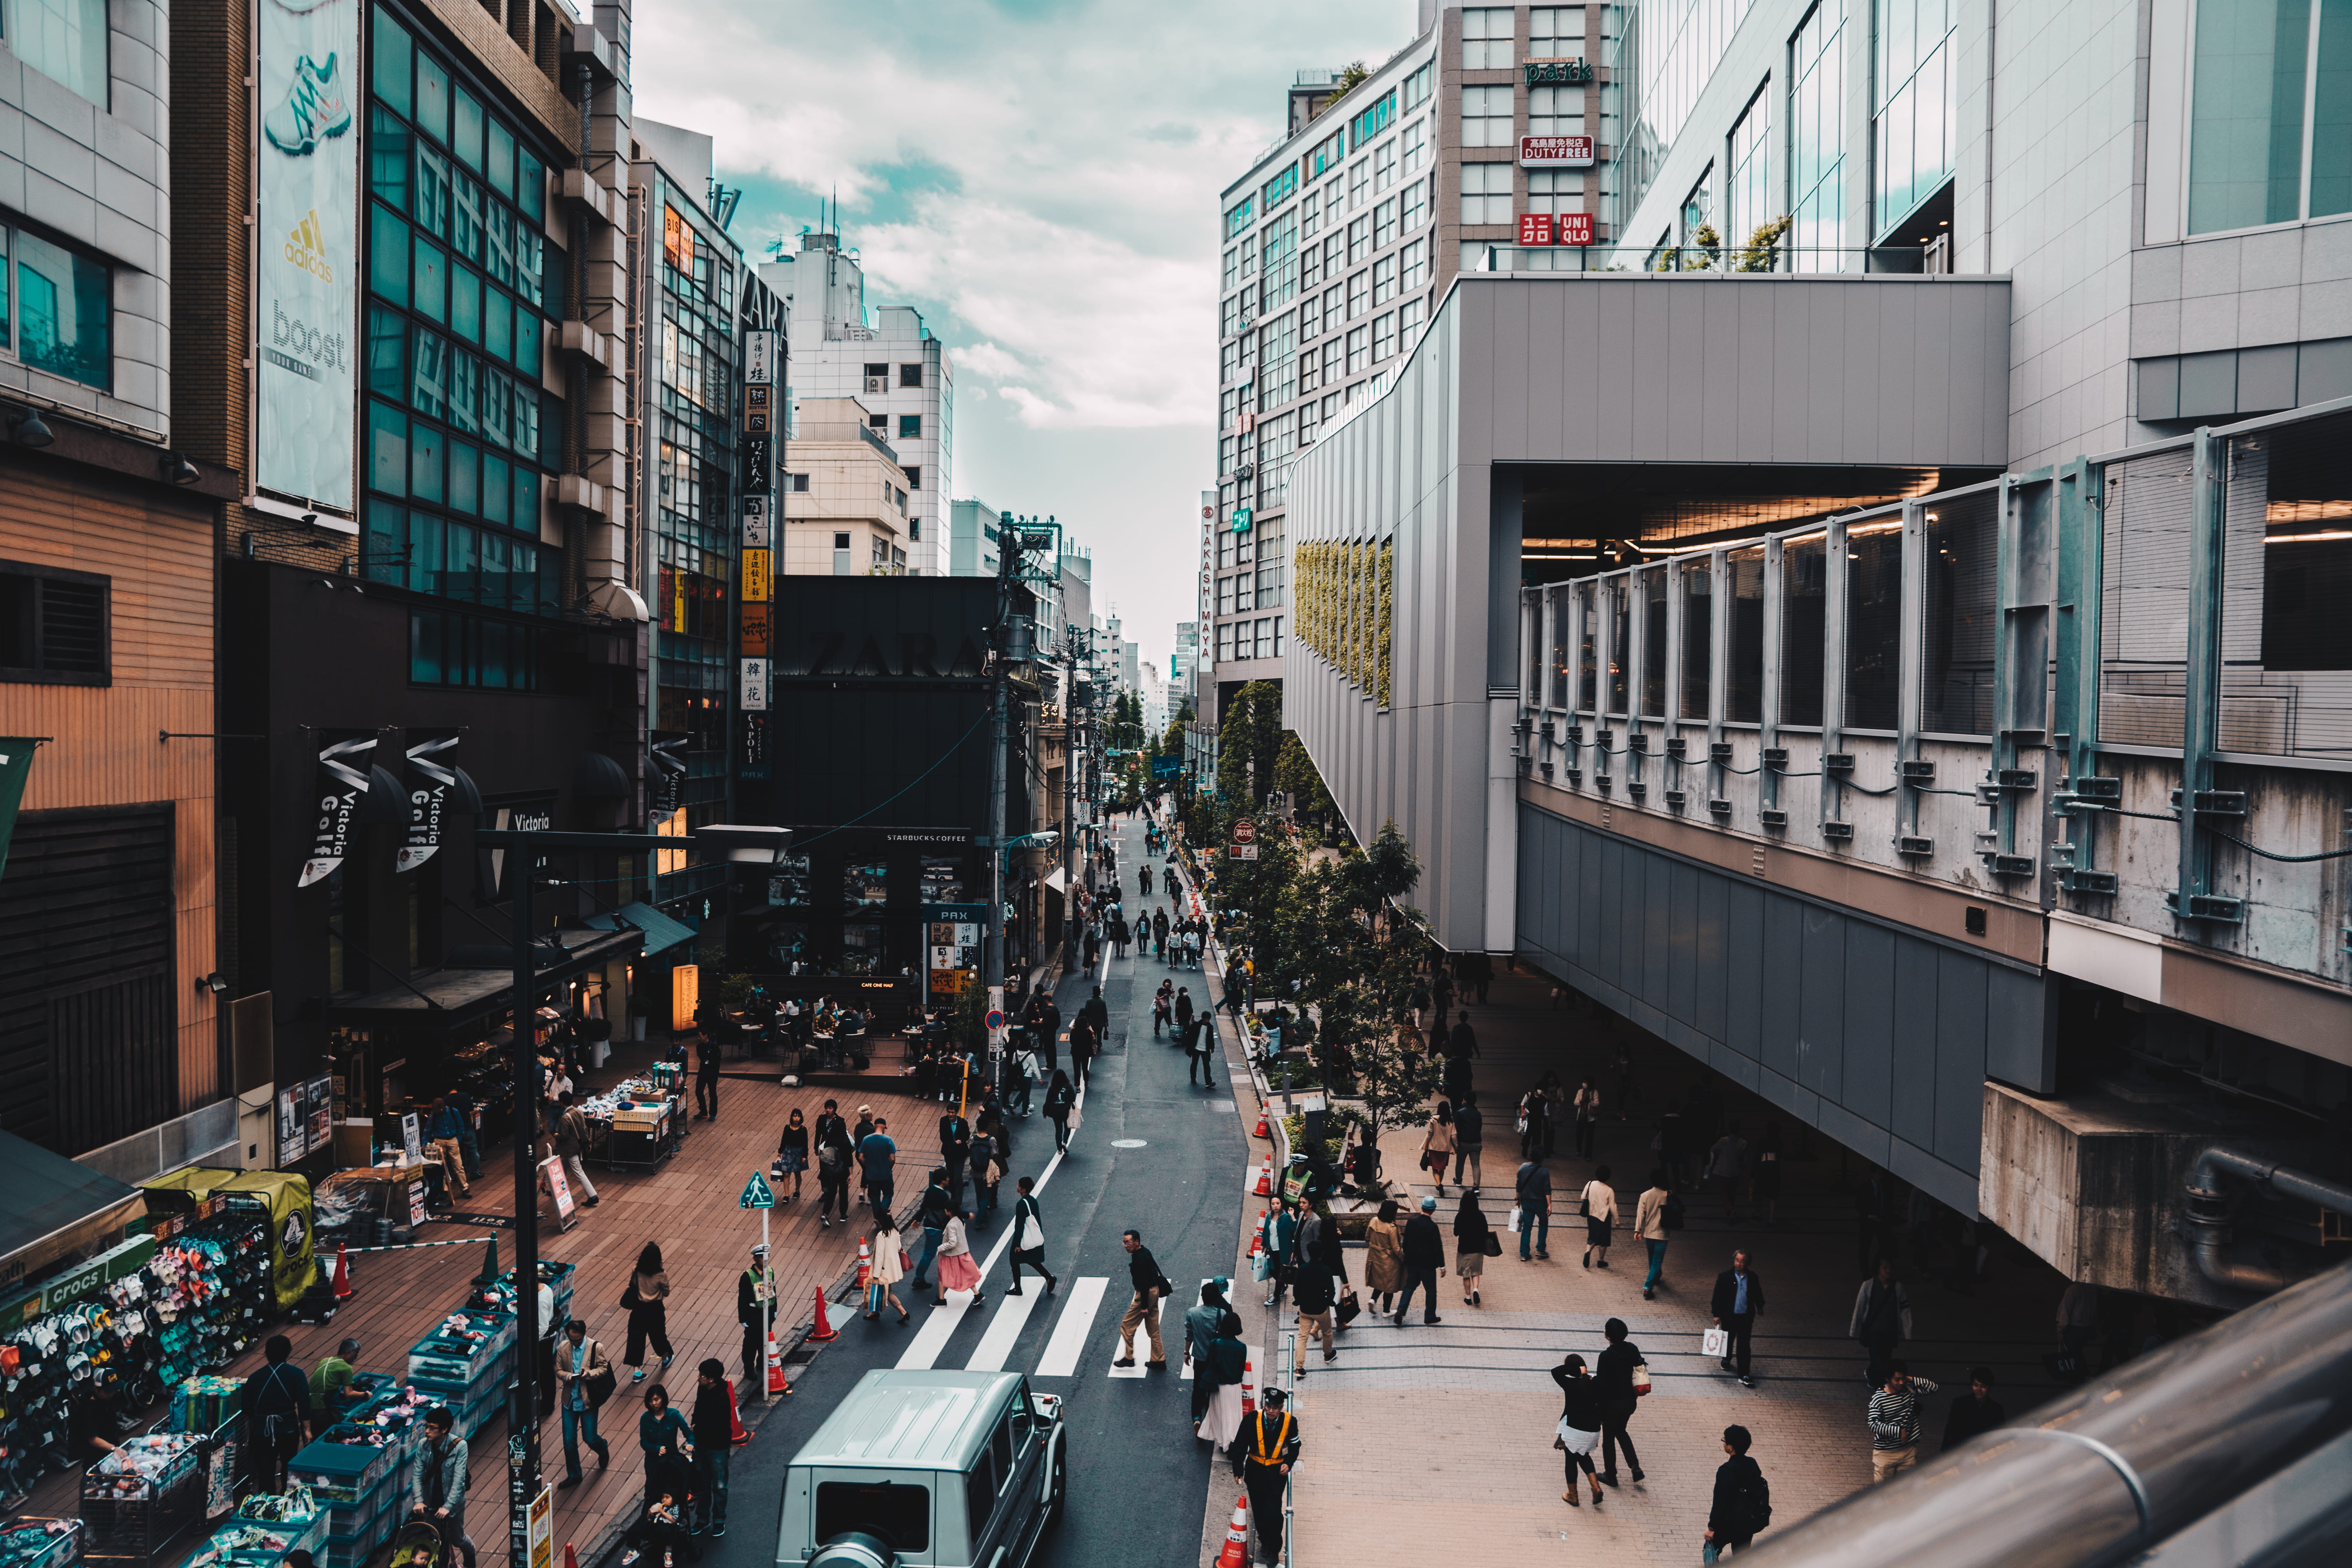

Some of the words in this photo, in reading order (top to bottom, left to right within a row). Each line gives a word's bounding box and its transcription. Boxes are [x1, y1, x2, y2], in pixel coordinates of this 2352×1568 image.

[1524, 57, 1592, 86] park
[1563, 217, 1586, 228] UNI
[1563, 230, 1589, 243] QLO
[285, 243, 332, 283] adidas
[740, 263, 792, 361] ZARA
[274, 299, 345, 374] boost
[754, 332, 764, 360] 串揚げ
[272, 352, 290, 368] YOUR
[294, 362, 311, 377] GAME
[750, 367, 765, 380] 桂
[751, 416, 764, 428] 肉
[1234, 512, 1248, 529] ニトリ
[1202, 524, 1210, 657] TAKASHIMAYA
[808, 631, 983, 677] ZARA
[746, 662, 760, 676] 韓
[747, 686, 760, 701] 花
[670, 771, 679, 809] Victoria
[314, 796, 338, 855] Golf
[334, 791, 356, 855] Victoria
[409, 791, 429, 844] Golf
[429, 785, 444, 844] Victoria
[515, 812, 549, 831] Victoria
[405, 1130, 417, 1147] GW
[407, 1147, 419, 1159] SALE
[551, 1165, 560, 1174] Tax
[553, 1172, 563, 1183] Free
[280, 1253, 309, 1279] crocs
[53, 1272, 98, 1303] crocs
